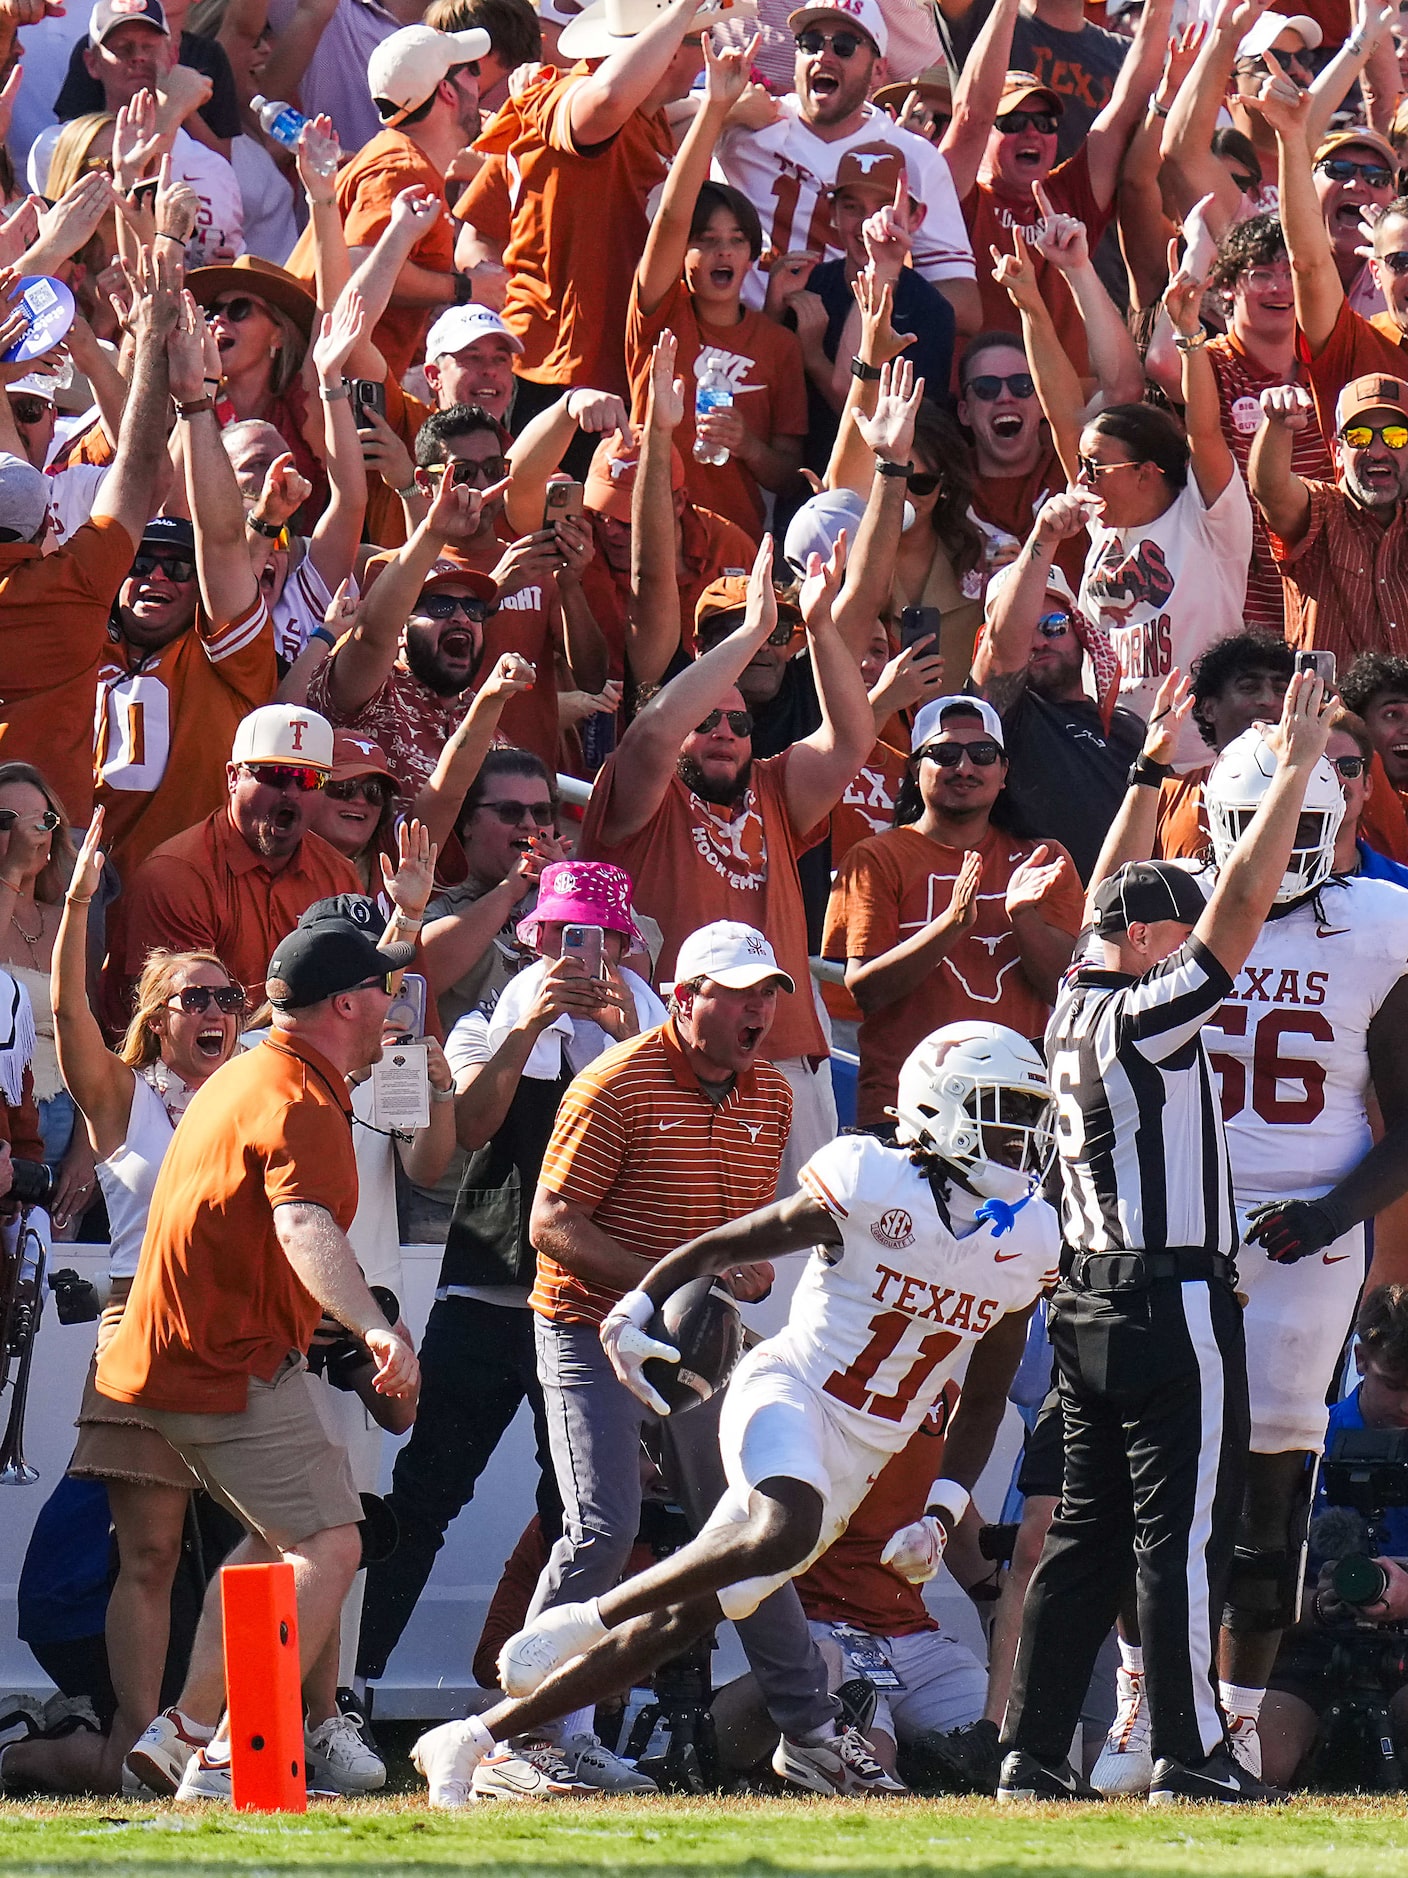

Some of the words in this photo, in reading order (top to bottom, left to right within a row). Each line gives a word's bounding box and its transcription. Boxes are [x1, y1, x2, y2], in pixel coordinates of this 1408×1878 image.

[290, 720, 308, 750] T
[692, 827, 727, 877] HOOK
[882, 1211, 912, 1238] SEC
[872, 1263, 999, 1334] TEXAS
[823, 1311, 963, 1423] 11
